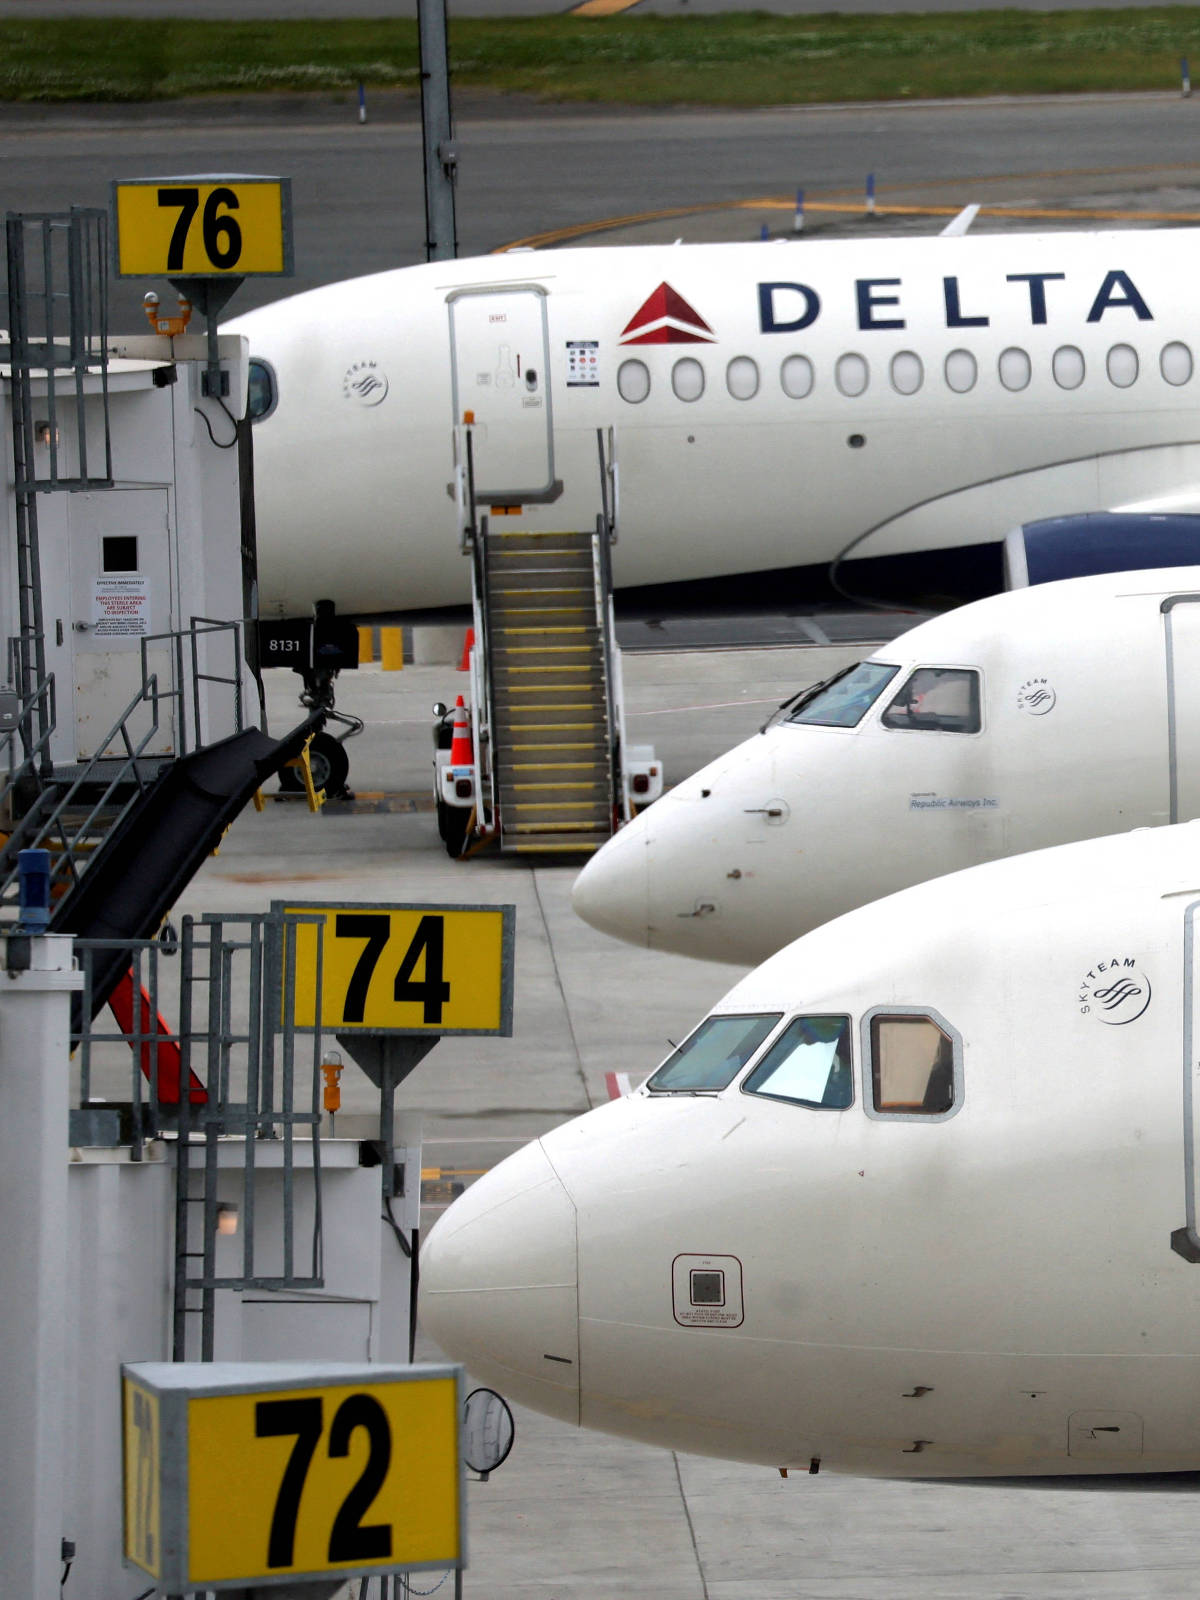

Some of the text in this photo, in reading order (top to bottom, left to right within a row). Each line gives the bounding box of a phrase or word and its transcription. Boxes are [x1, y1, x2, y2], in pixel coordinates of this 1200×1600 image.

[157, 187, 243, 271] 76
[759, 270, 1153, 333] DELTA
[269, 640, 300, 652] 8131
[911, 799, 946, 808] Republic
[948, 799, 981, 808] Airways
[335, 914, 451, 1023] 74
[1079, 958, 1136, 1014] SKYTEAM
[255, 1393, 393, 1568] 72
